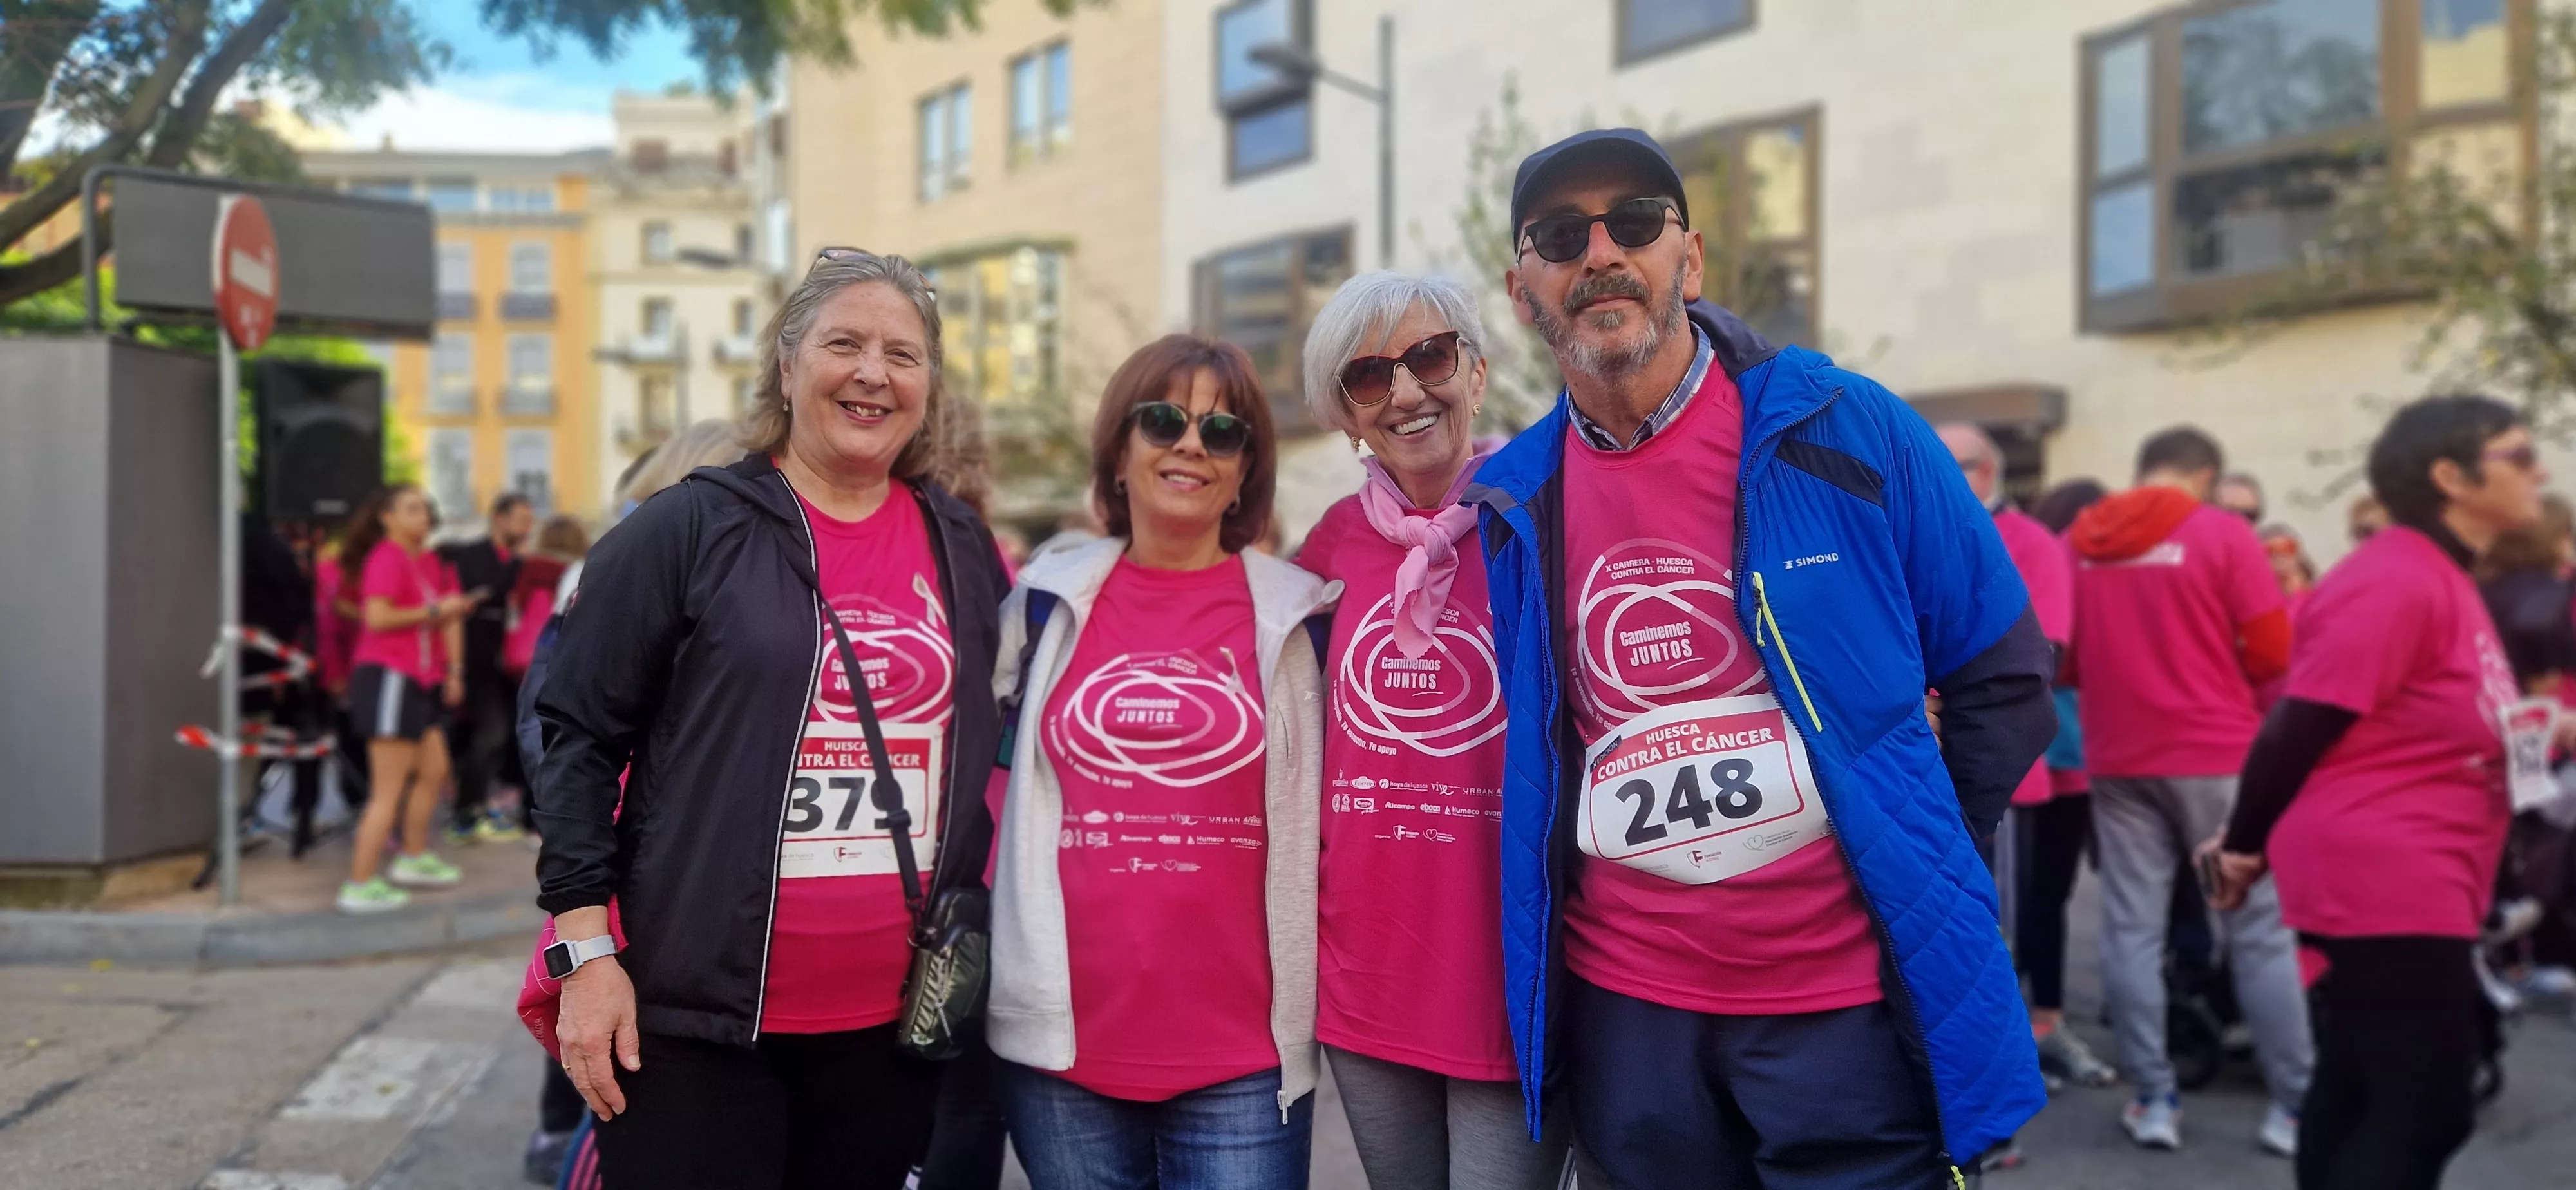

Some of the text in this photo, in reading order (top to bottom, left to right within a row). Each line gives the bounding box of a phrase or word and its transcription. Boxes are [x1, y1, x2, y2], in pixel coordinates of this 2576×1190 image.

[1613, 558, 1650, 571] CARRERA
[1656, 558, 1693, 566] HUESCA
[1795, 552, 1839, 567] SIMOND
[1611, 565, 1694, 580] CONTRA EL CÁNCER
[1620, 621, 1692, 647] Caminemos
[1630, 638, 1692, 667] JUNTOS
[1381, 656, 1441, 671] Caminemos
[835, 672, 887, 691] JUOS
[1384, 672, 1437, 690] JUNTOS
[1115, 697, 1180, 709] Caminemos
[1117, 710, 1175, 723] JUNTOS
[1646, 723, 1701, 745] HUESCA
[824, 741, 868, 751] HUESCA
[1377, 745, 1397, 756] apoyo
[1598, 727, 1774, 780] CONTRA EL CÁNCER
[839, 754, 853, 767] EL
[1385, 801, 1416, 810] Alcampo
[1615, 758, 1763, 847] 248
[1452, 806, 1480, 815] Humeco
